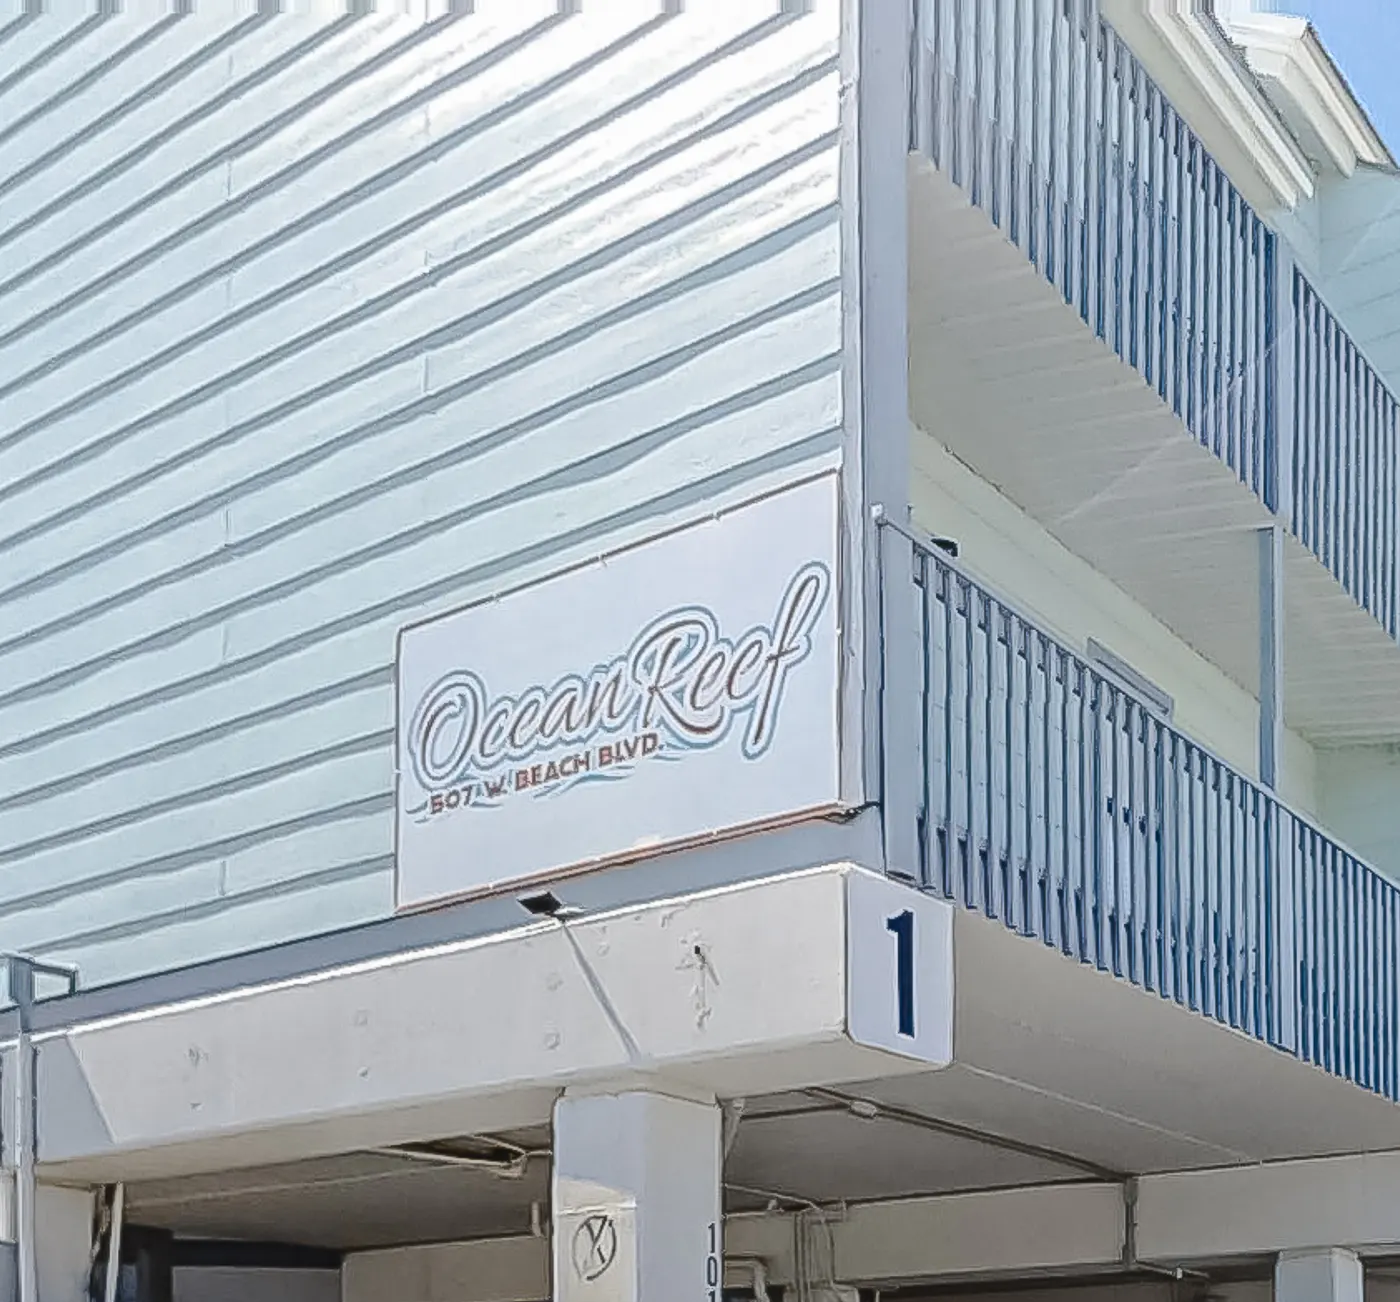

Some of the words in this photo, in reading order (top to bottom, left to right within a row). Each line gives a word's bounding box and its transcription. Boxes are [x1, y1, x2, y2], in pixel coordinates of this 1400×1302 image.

[416, 666, 632, 784] Ocean
[632, 571, 825, 750] Reef
[428, 786, 473, 815] 507
[514, 750, 592, 792] BEACH
[886, 908, 916, 1040] 1
